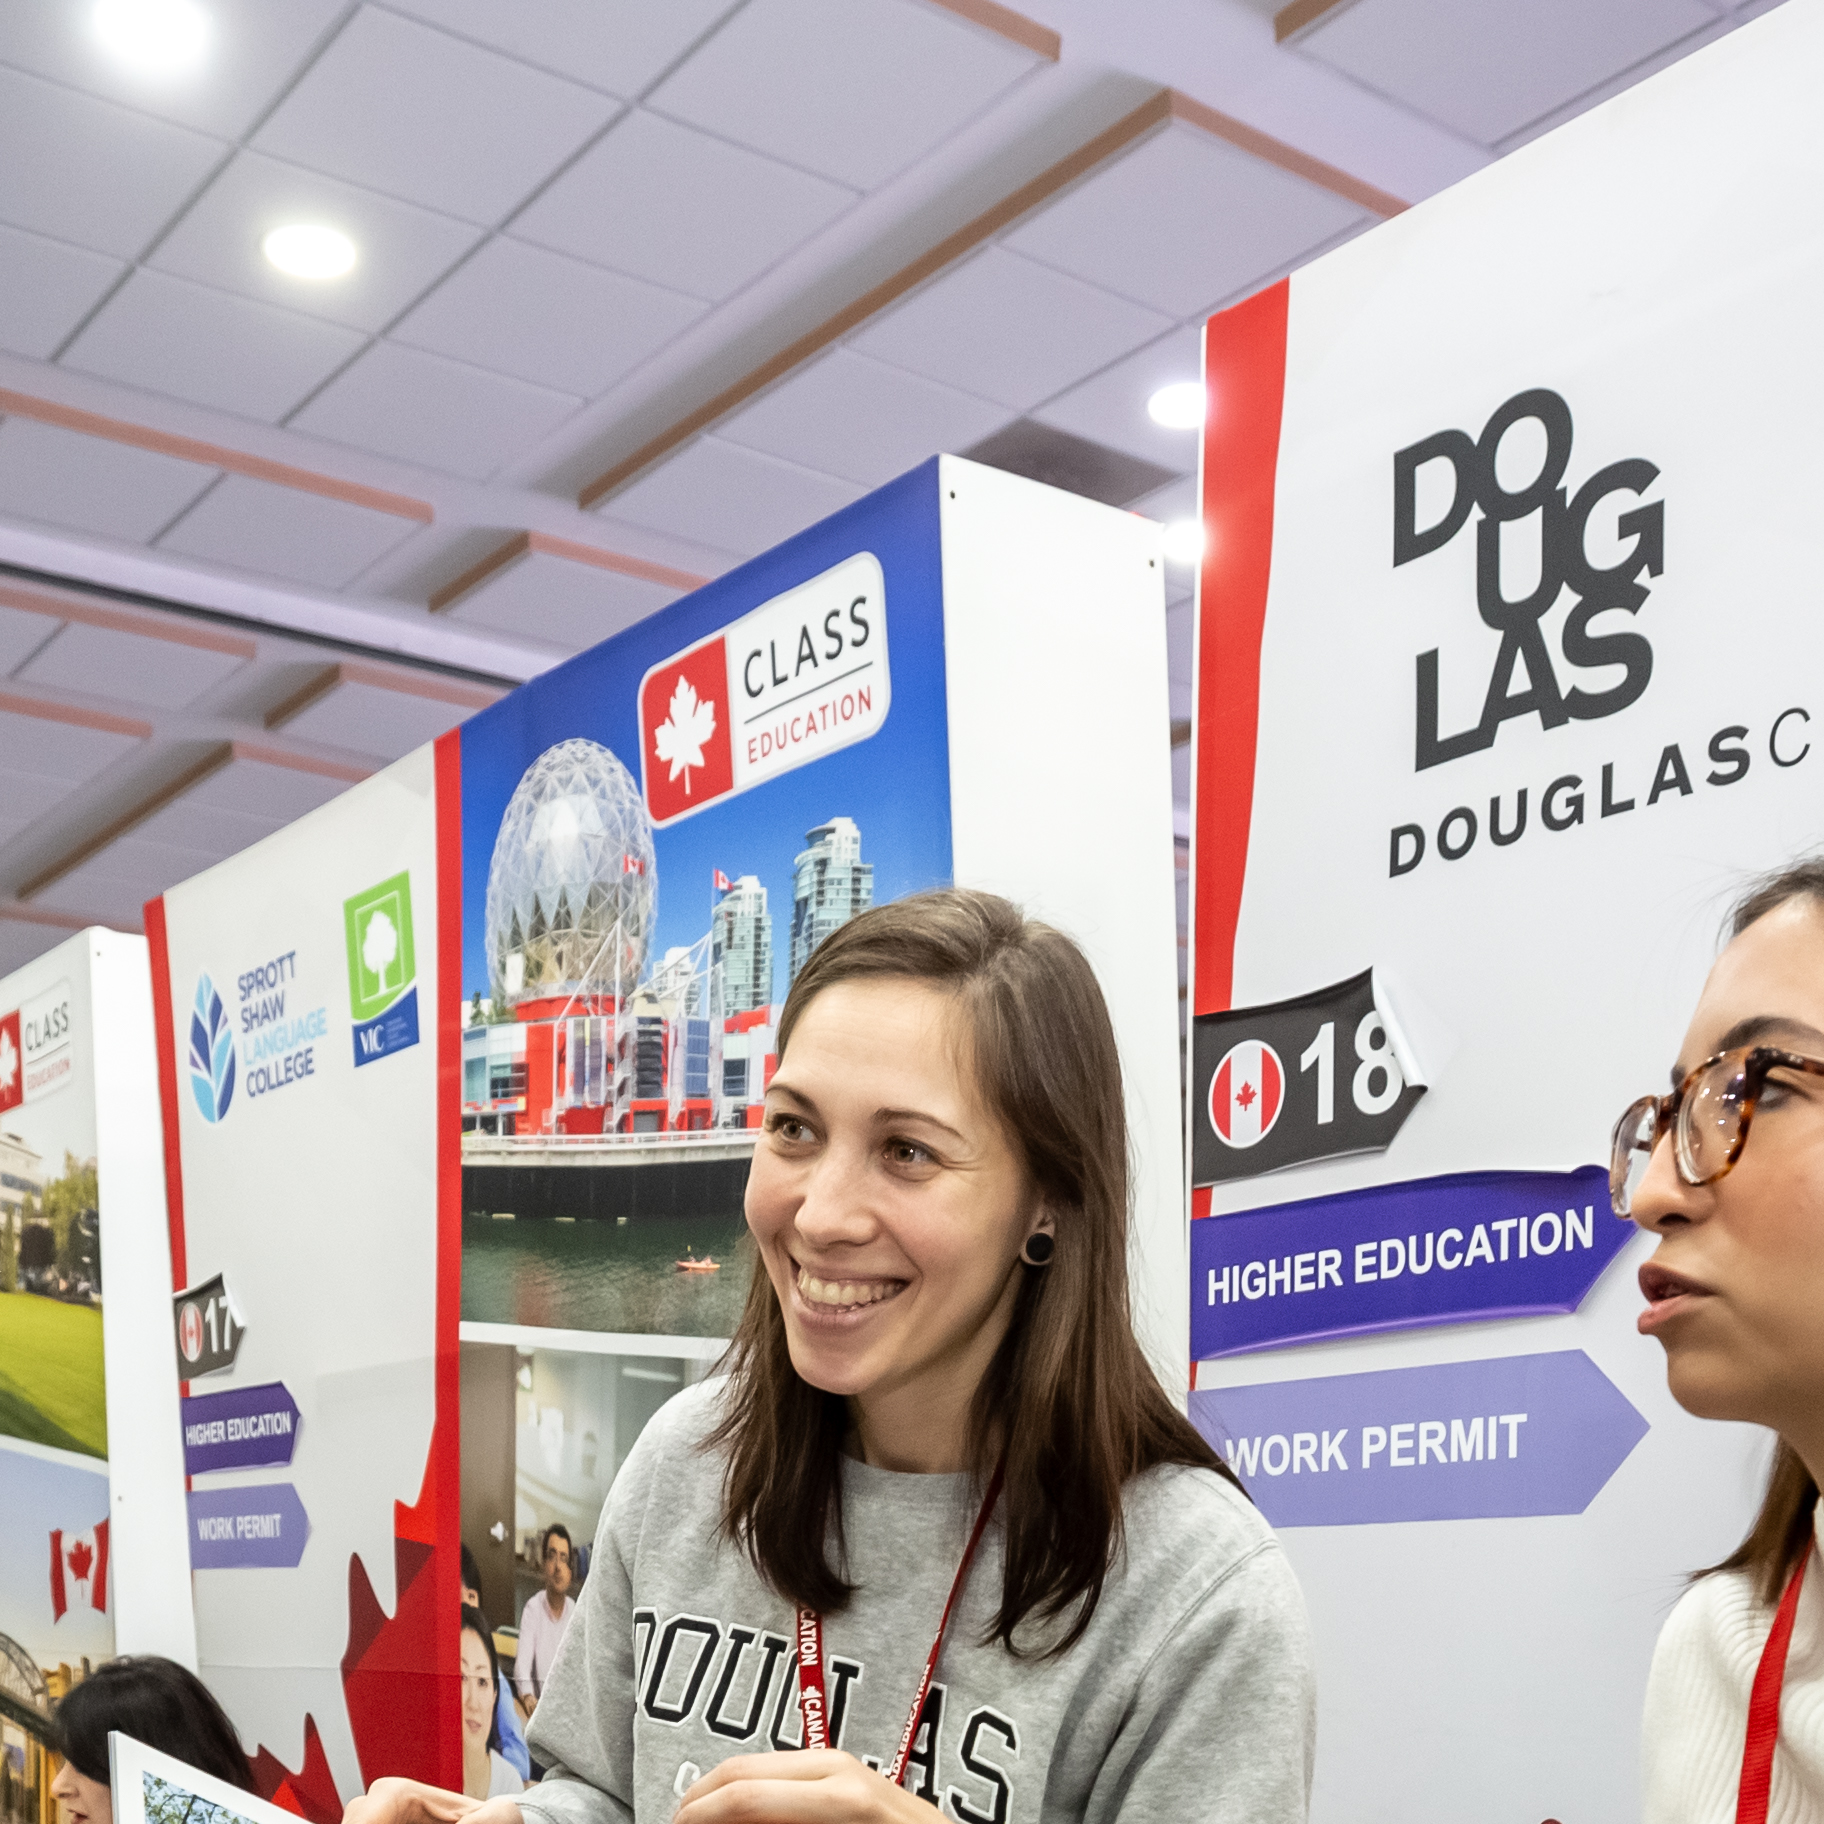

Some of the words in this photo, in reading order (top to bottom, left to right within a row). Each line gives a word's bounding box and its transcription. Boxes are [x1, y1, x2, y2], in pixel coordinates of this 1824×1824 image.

[744, 595, 870, 698] CLASS
[748, 685, 872, 764] EDUCATION
[238, 950, 296, 1002] SPROTT
[25, 1001, 68, 1051] CLASS
[241, 990, 285, 1033] SHAW
[243, 1007, 328, 1066] LANGUAGE
[246, 1047, 315, 1098] COLLEGE
[1300, 1011, 1404, 1126] 18
[1207, 1248, 1344, 1306] HIGHER
[1354, 1205, 1595, 1284] EDUCATION
[204, 1296, 233, 1353] 17
[185, 1420, 225, 1446] HIGHER
[227, 1411, 291, 1442] EDUCATION
[1226, 1428, 1349, 1478] WORK
[1361, 1413, 1528, 1470] PERMIT
[197, 1516, 235, 1541] WORK
[236, 1513, 281, 1539] PERMIT
